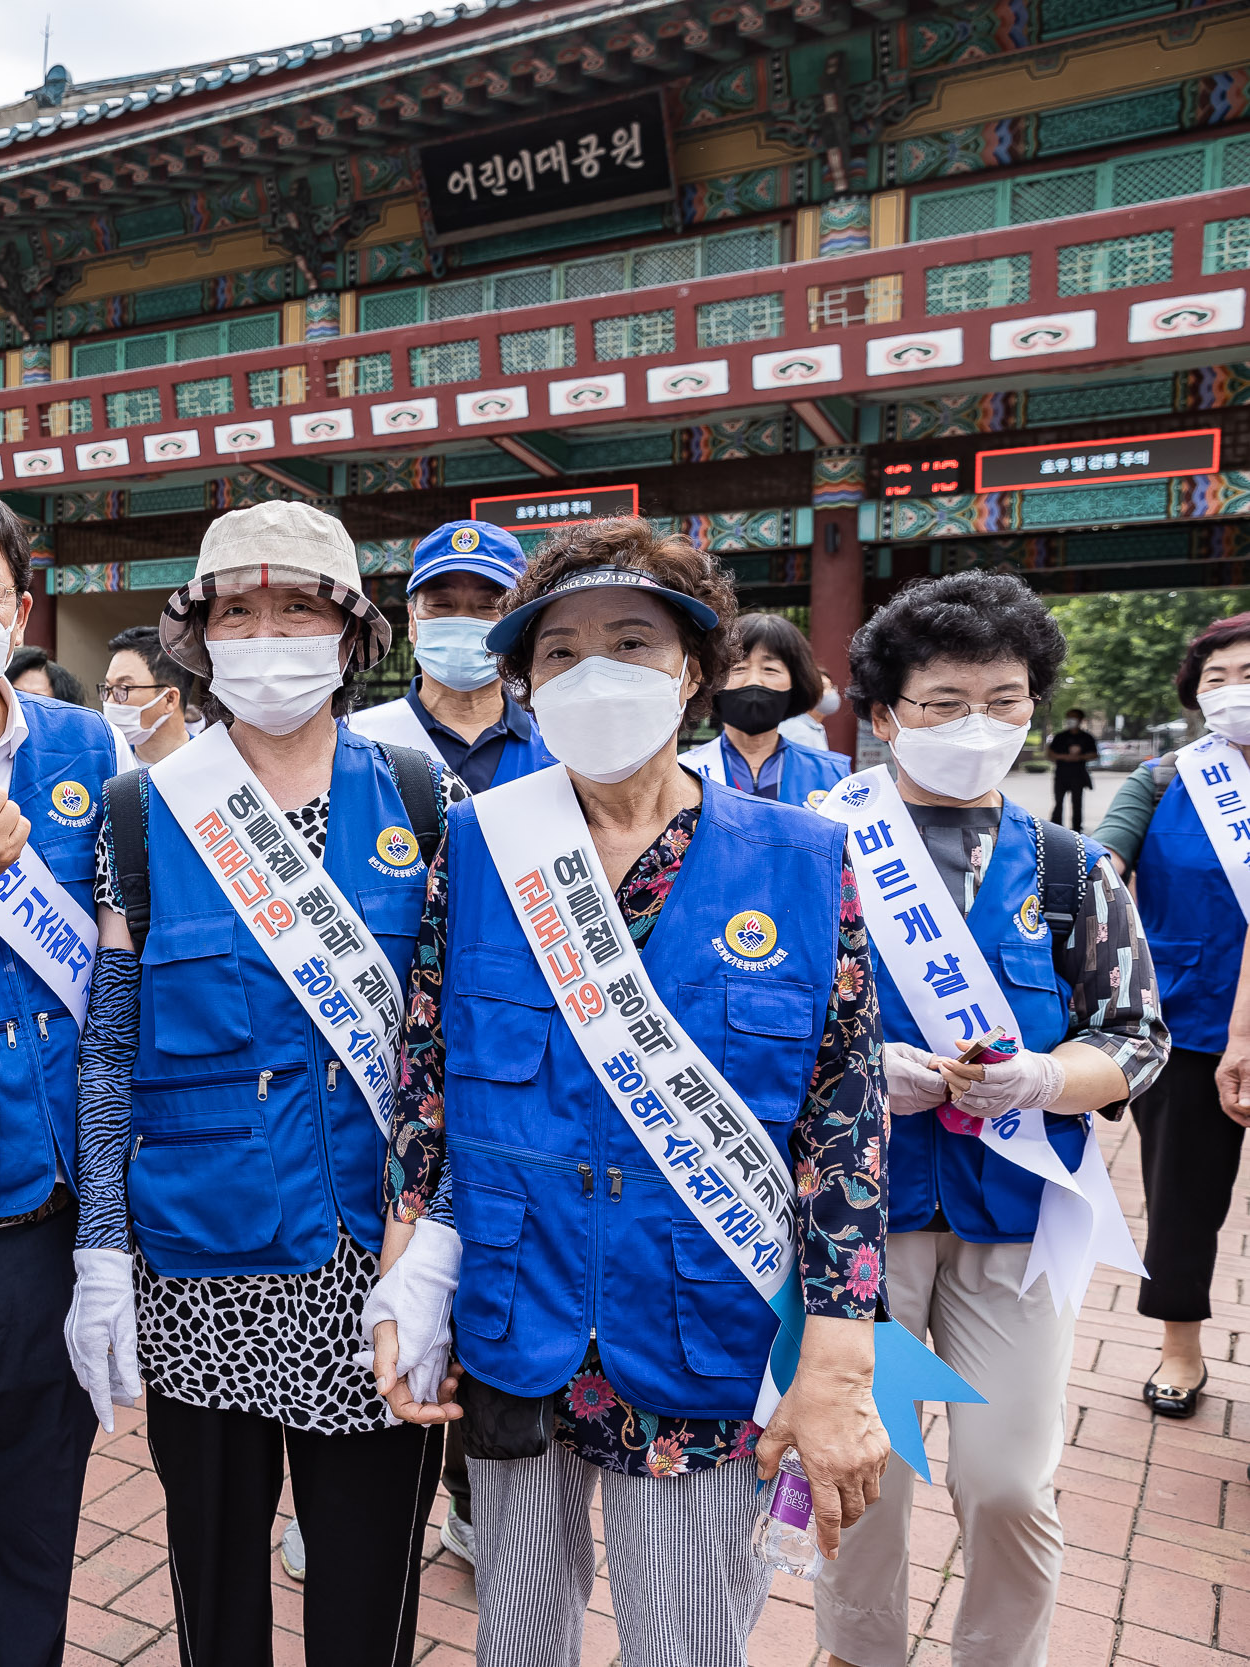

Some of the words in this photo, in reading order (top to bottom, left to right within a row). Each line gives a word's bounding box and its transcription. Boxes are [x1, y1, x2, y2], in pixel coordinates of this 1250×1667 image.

[447, 122, 644, 200] 어린이대공원
[555, 580, 581, 593] SINCE
[611, 575, 637, 583] 1948
[12, 886, 93, 983] 기초질서
[195, 811, 294, 937] 코로나19
[292, 956, 361, 1026] 방역
[228, 786, 306, 884] 여름철
[296, 885, 362, 958] 행락
[553, 850, 620, 963] 여름철
[606, 972, 676, 1055] 행락
[514, 868, 603, 1024] 코로나19
[602, 1050, 676, 1130] 방역
[663, 1134, 781, 1276] 수칙준수
[784, 1495, 810, 1512] BEST
